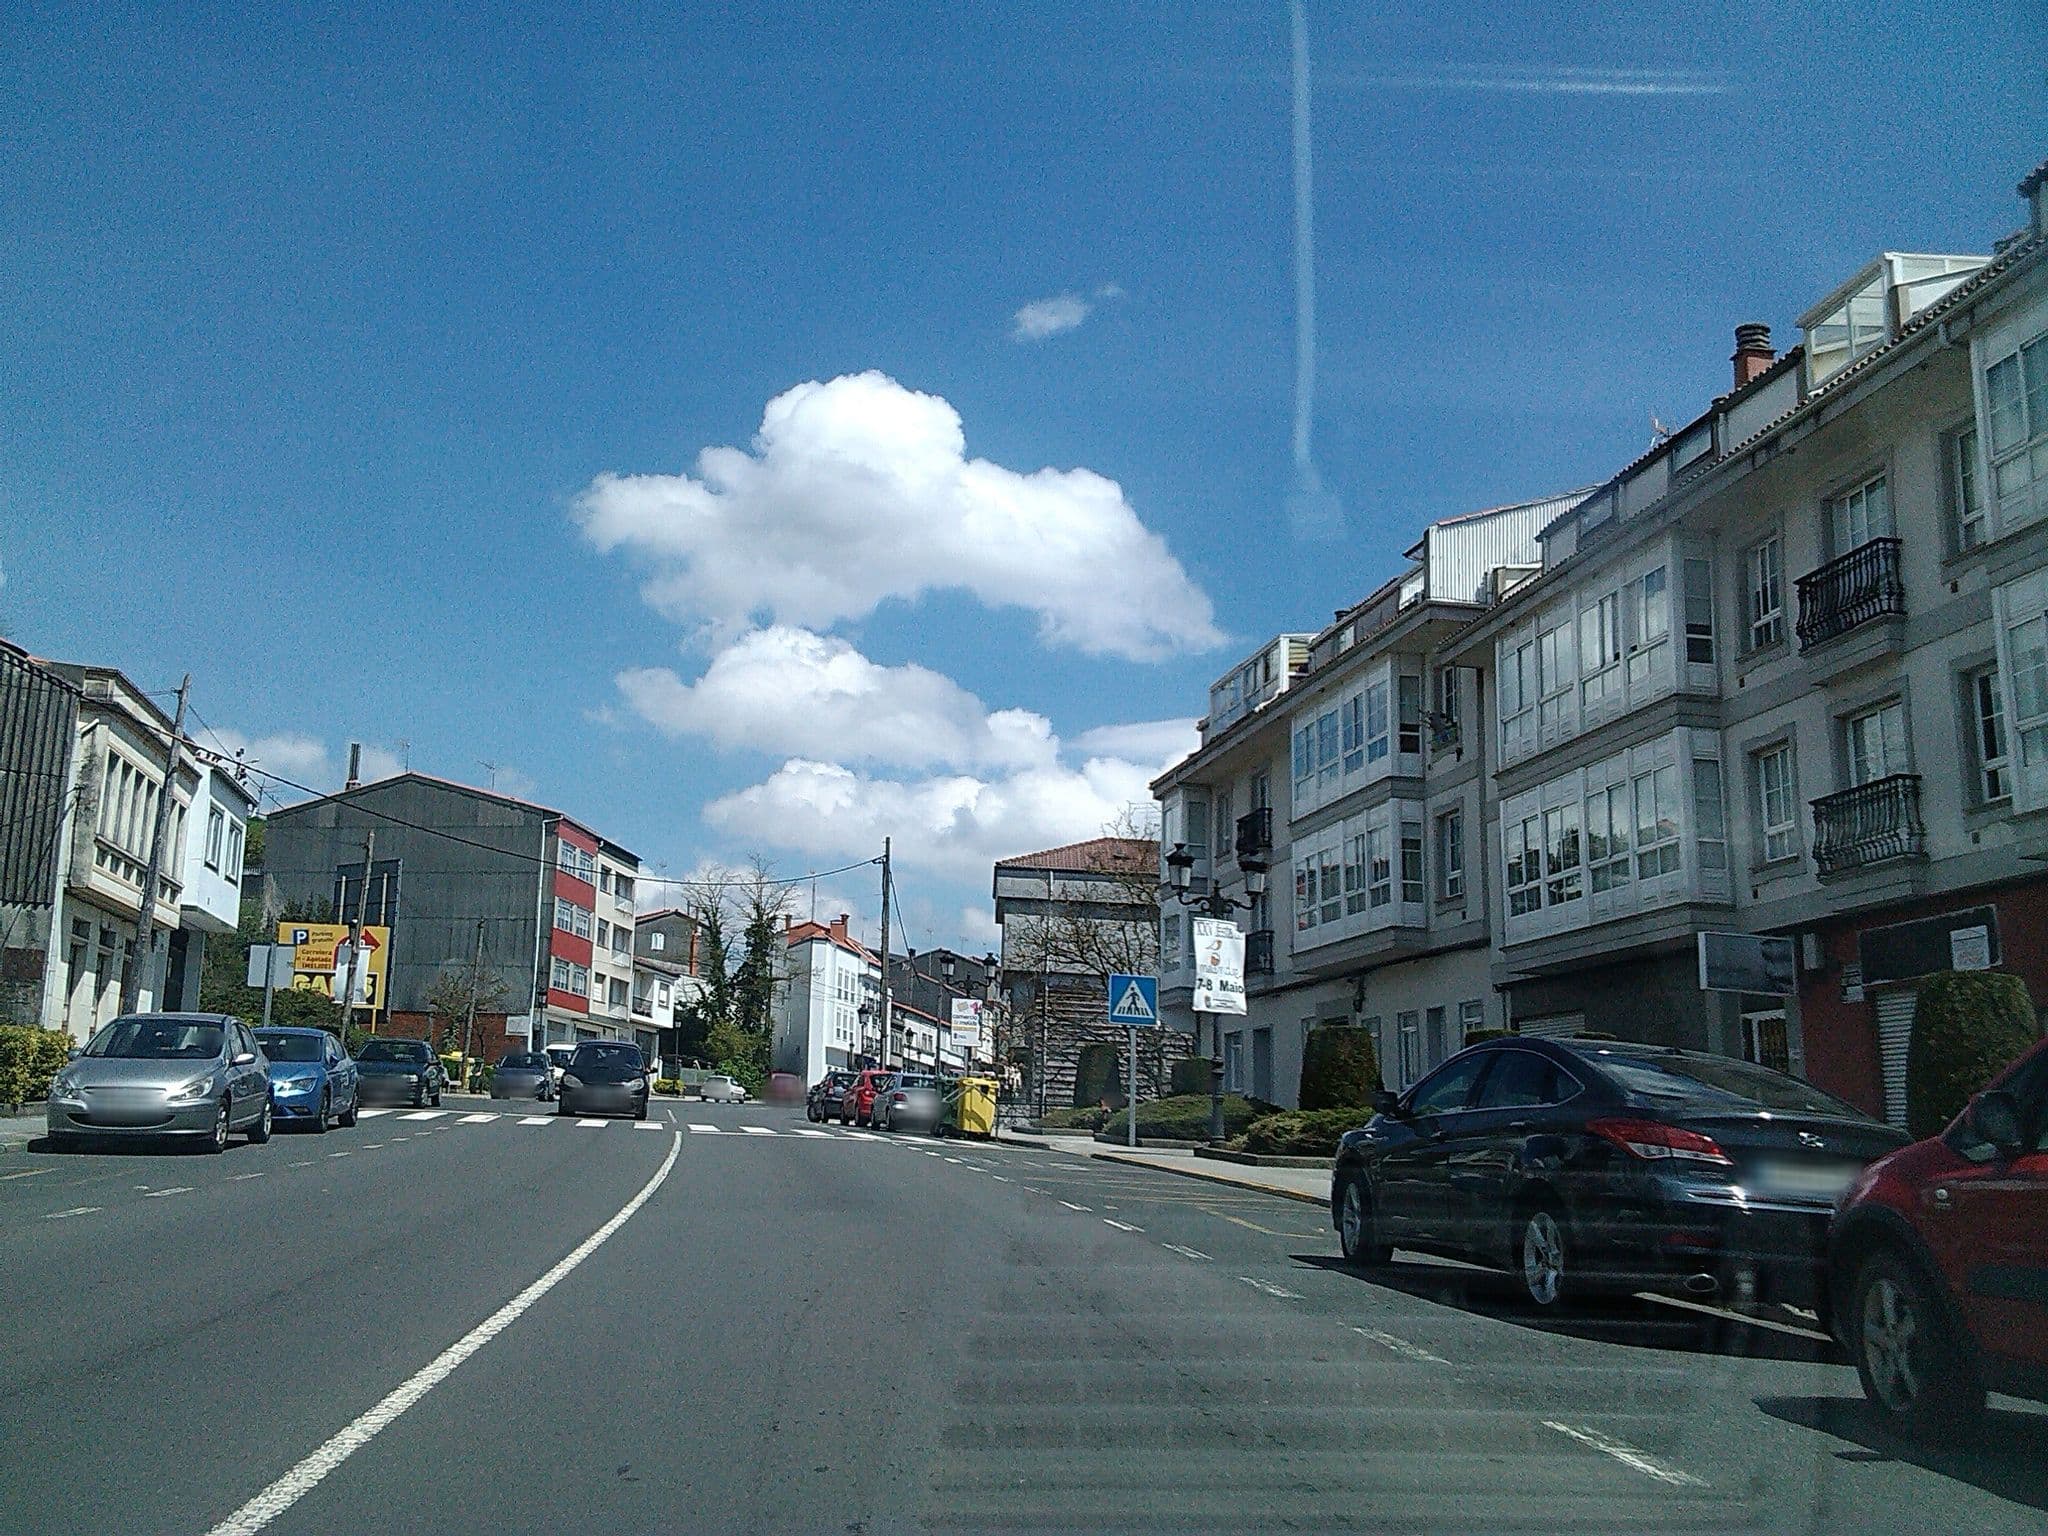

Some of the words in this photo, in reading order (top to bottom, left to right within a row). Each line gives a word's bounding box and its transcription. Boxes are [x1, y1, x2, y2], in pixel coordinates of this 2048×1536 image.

[297, 931, 307, 945] P
[1197, 978, 1213, 991] 7-8
[1219, 979, 1246, 994] Maio
